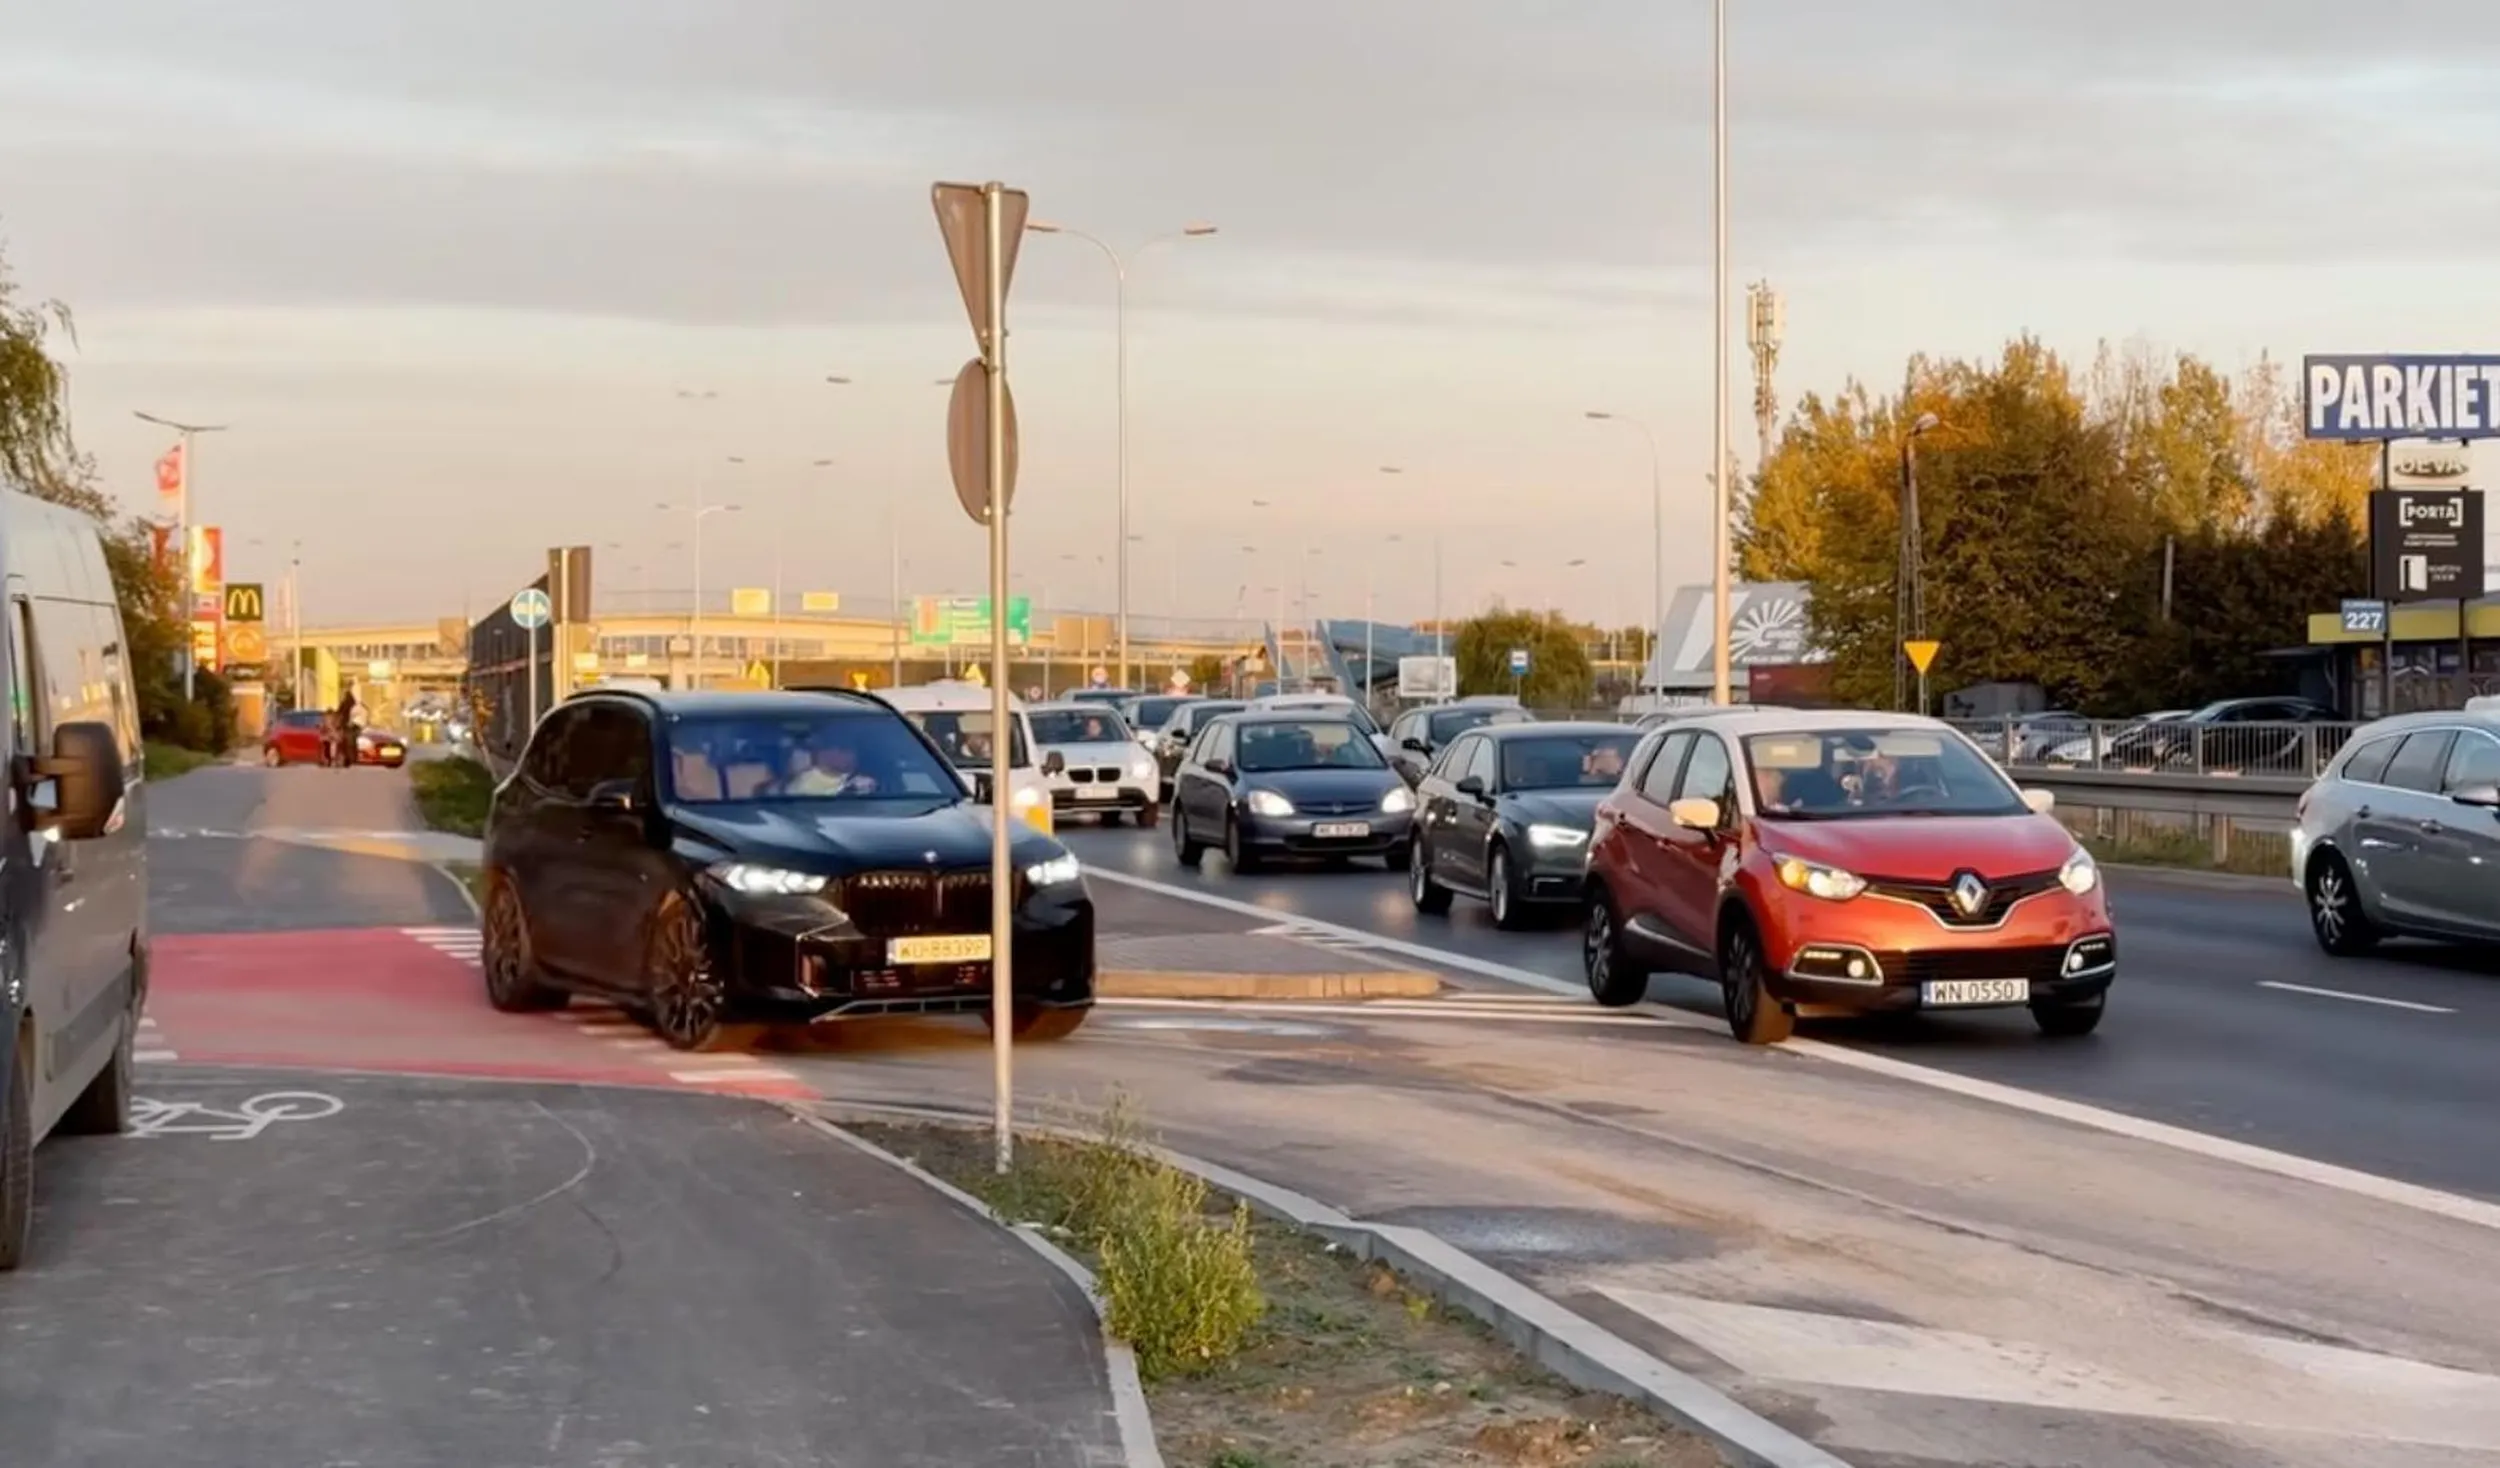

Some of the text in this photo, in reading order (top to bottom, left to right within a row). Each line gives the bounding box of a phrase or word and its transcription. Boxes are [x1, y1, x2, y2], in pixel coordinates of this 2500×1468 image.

[2347, 612, 2383, 629] 227
[1935, 980, 2025, 1001] WN 0550J
